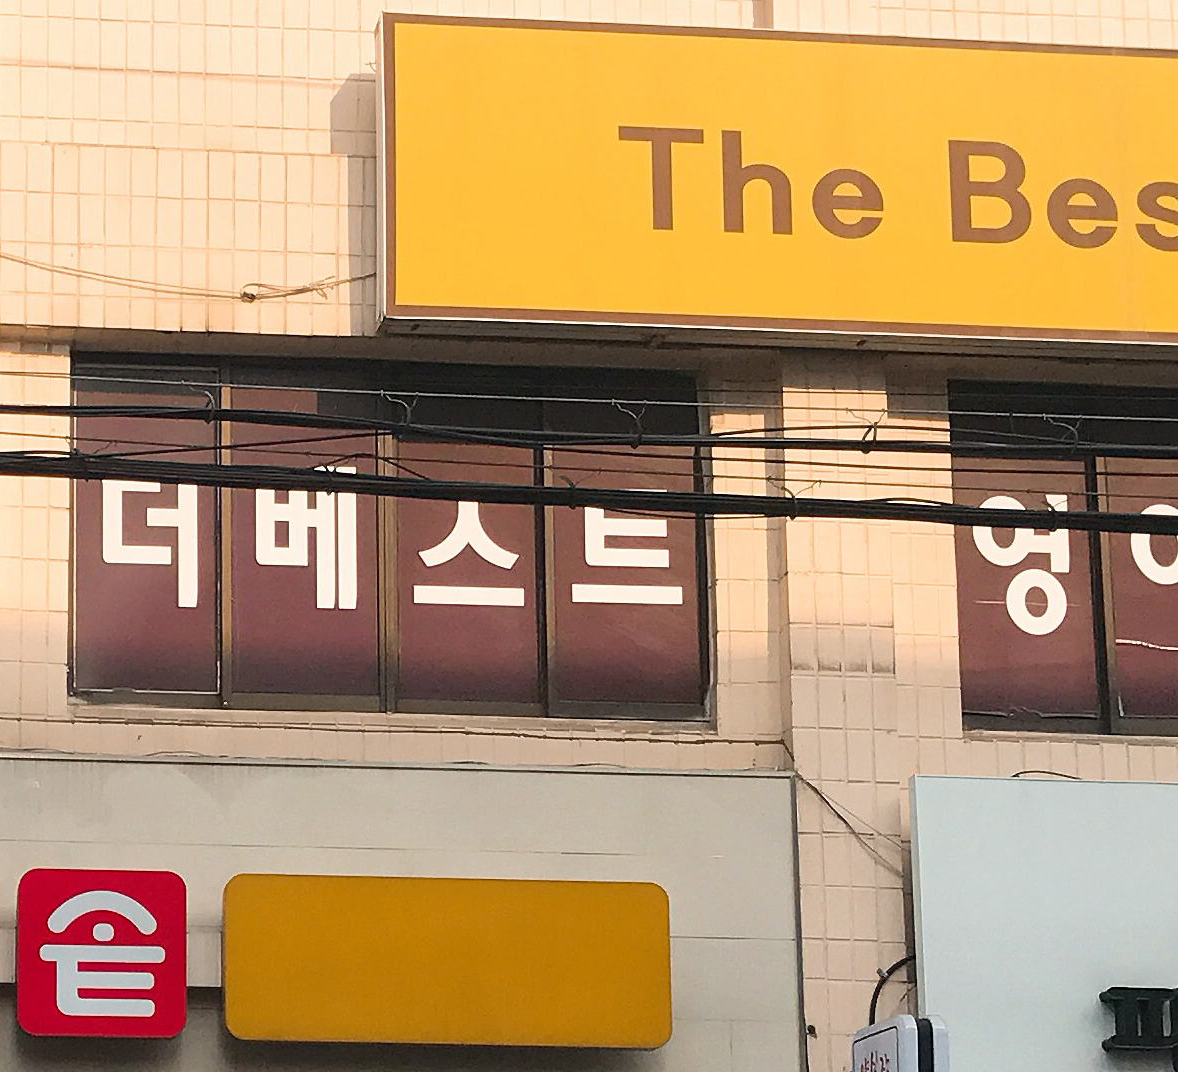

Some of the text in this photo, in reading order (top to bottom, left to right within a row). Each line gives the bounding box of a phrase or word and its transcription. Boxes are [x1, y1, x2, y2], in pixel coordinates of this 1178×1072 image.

[618, 126, 1178, 252] The Bes
[102, 466, 683, 609] 더베스트
